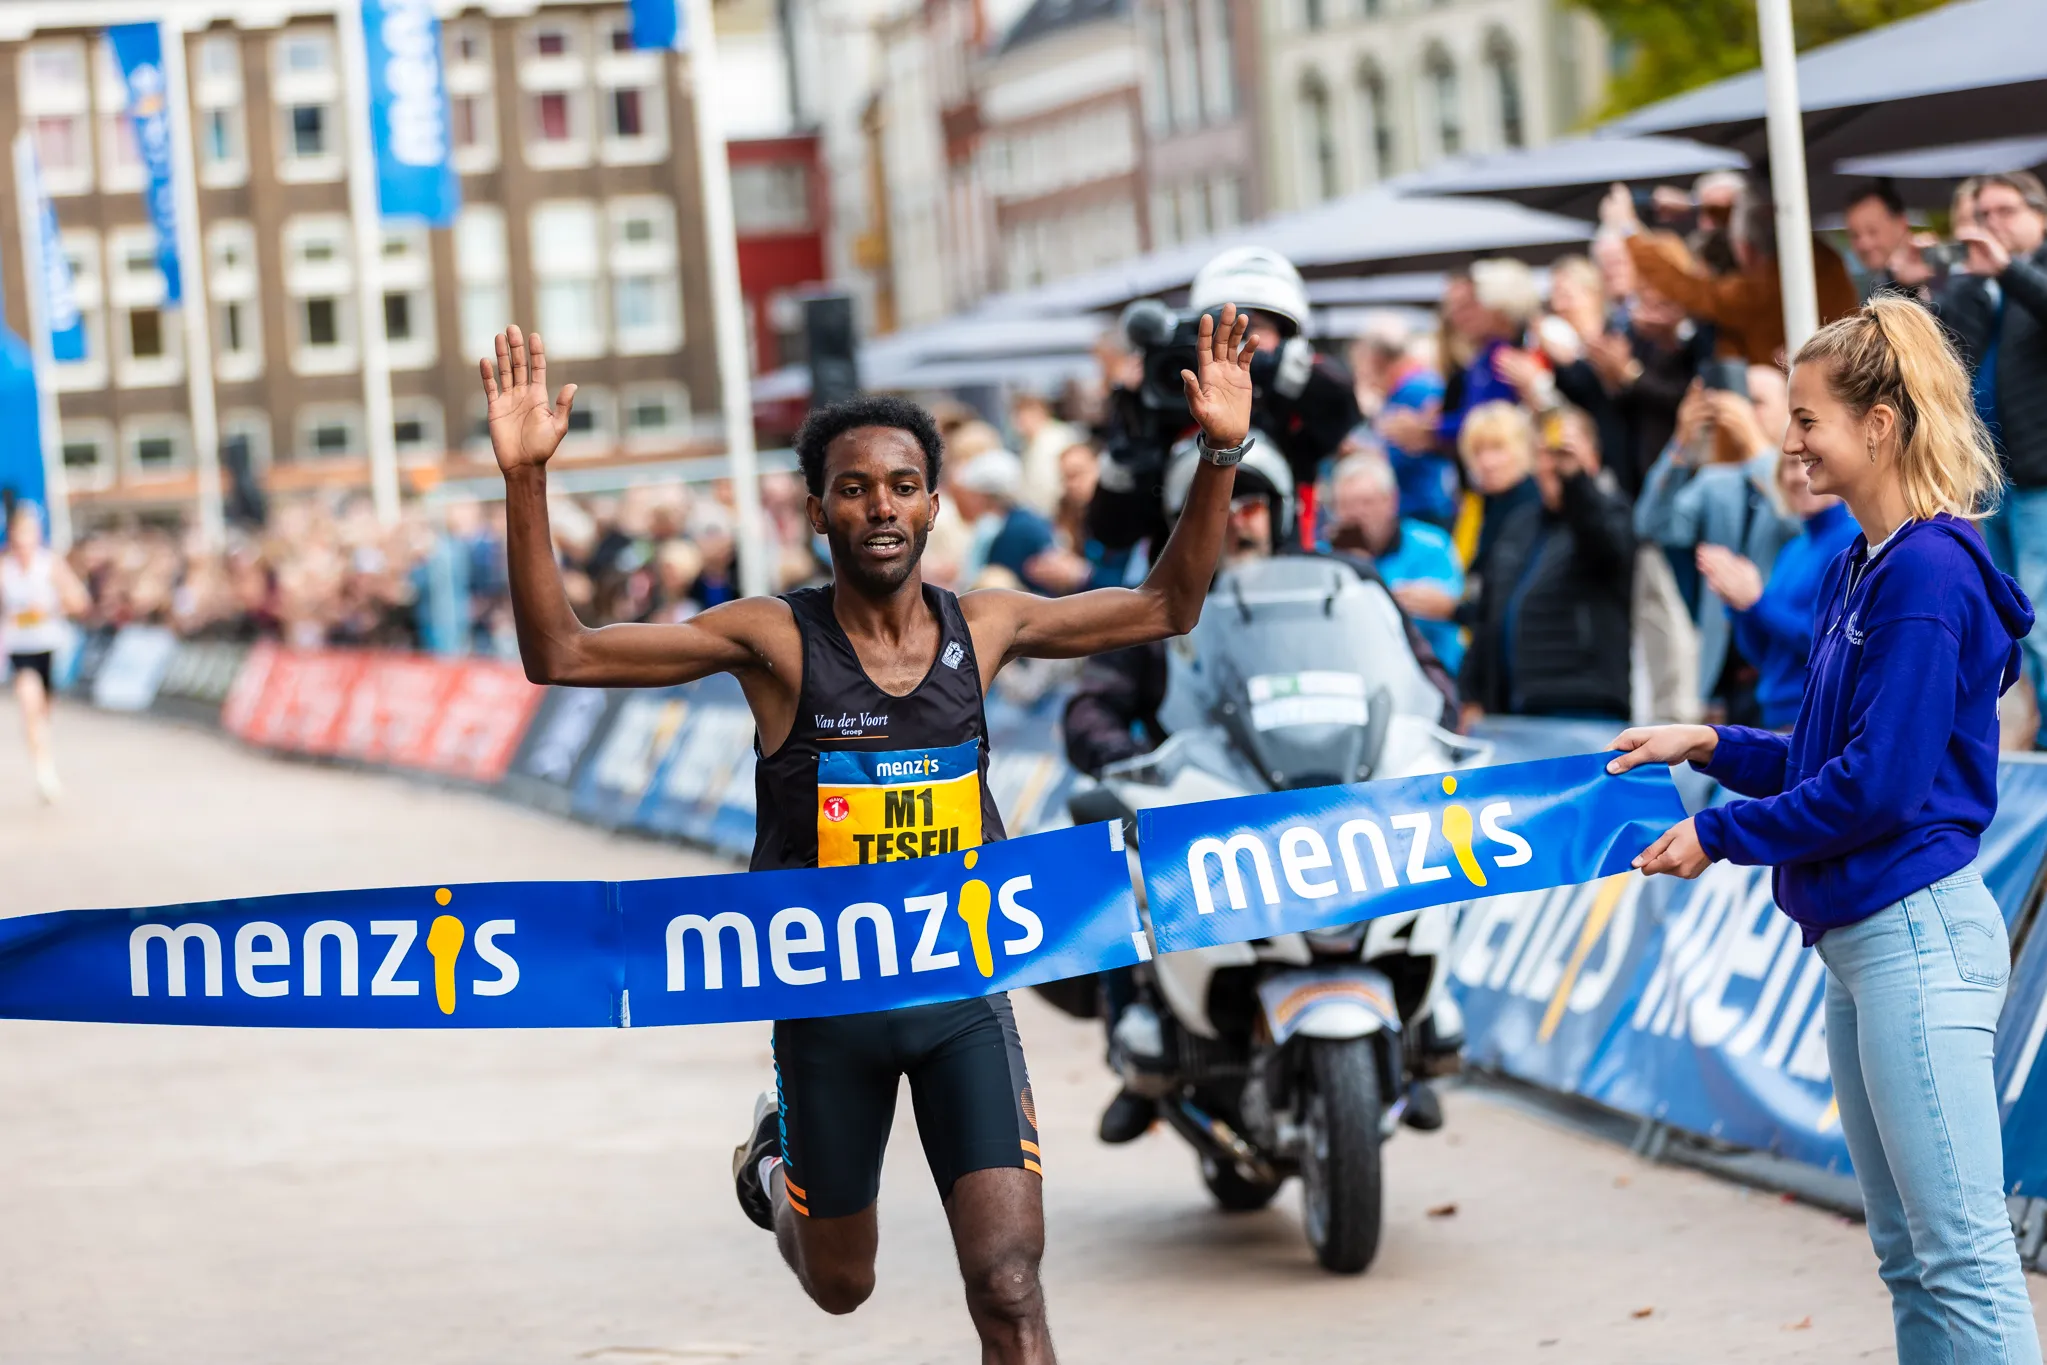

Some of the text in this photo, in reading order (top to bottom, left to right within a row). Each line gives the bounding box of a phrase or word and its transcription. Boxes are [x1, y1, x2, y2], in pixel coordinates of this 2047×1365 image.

[815, 712, 889, 729] Van der Voort
[841, 728, 863, 736] Groep
[876, 754, 940, 777] menzis
[831, 801, 840, 817] 1
[884, 787, 934, 829] M1
[1187, 775, 1534, 916] menzis
[666, 850, 1044, 992] menzis
[129, 888, 520, 1014] menzis
